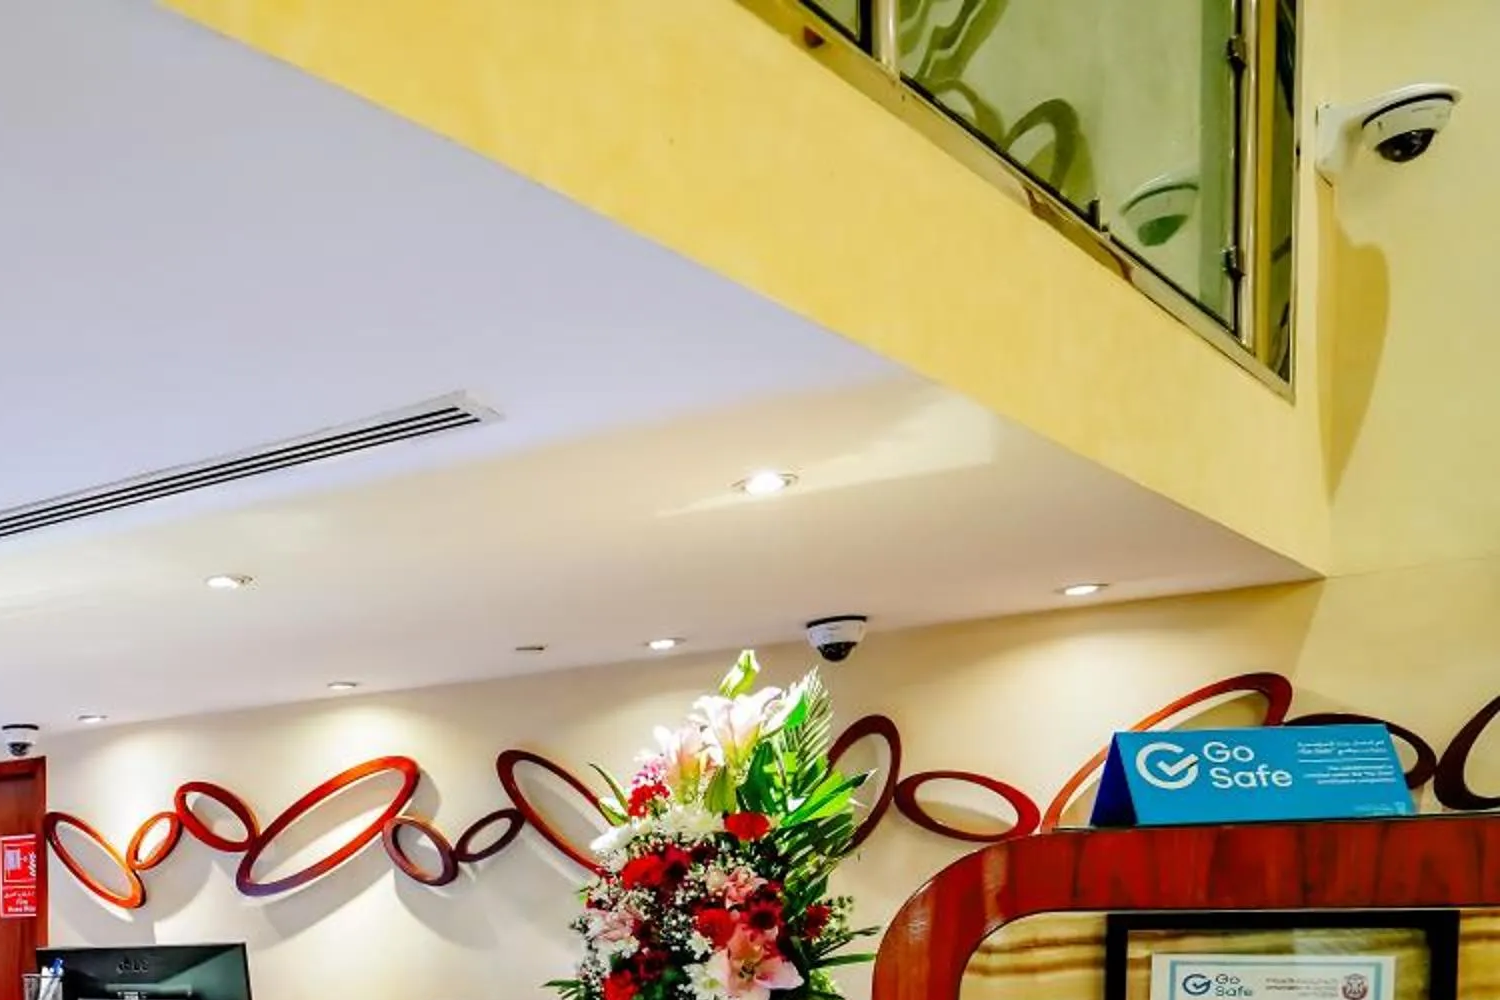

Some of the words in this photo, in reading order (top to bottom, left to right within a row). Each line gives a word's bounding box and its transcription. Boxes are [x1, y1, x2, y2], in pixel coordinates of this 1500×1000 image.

[1202, 740, 1256, 764] Go
[1209, 765, 1294, 790] Safe
[1214, 973, 1242, 985] Go
[1214, 985, 1255, 998] Safe
